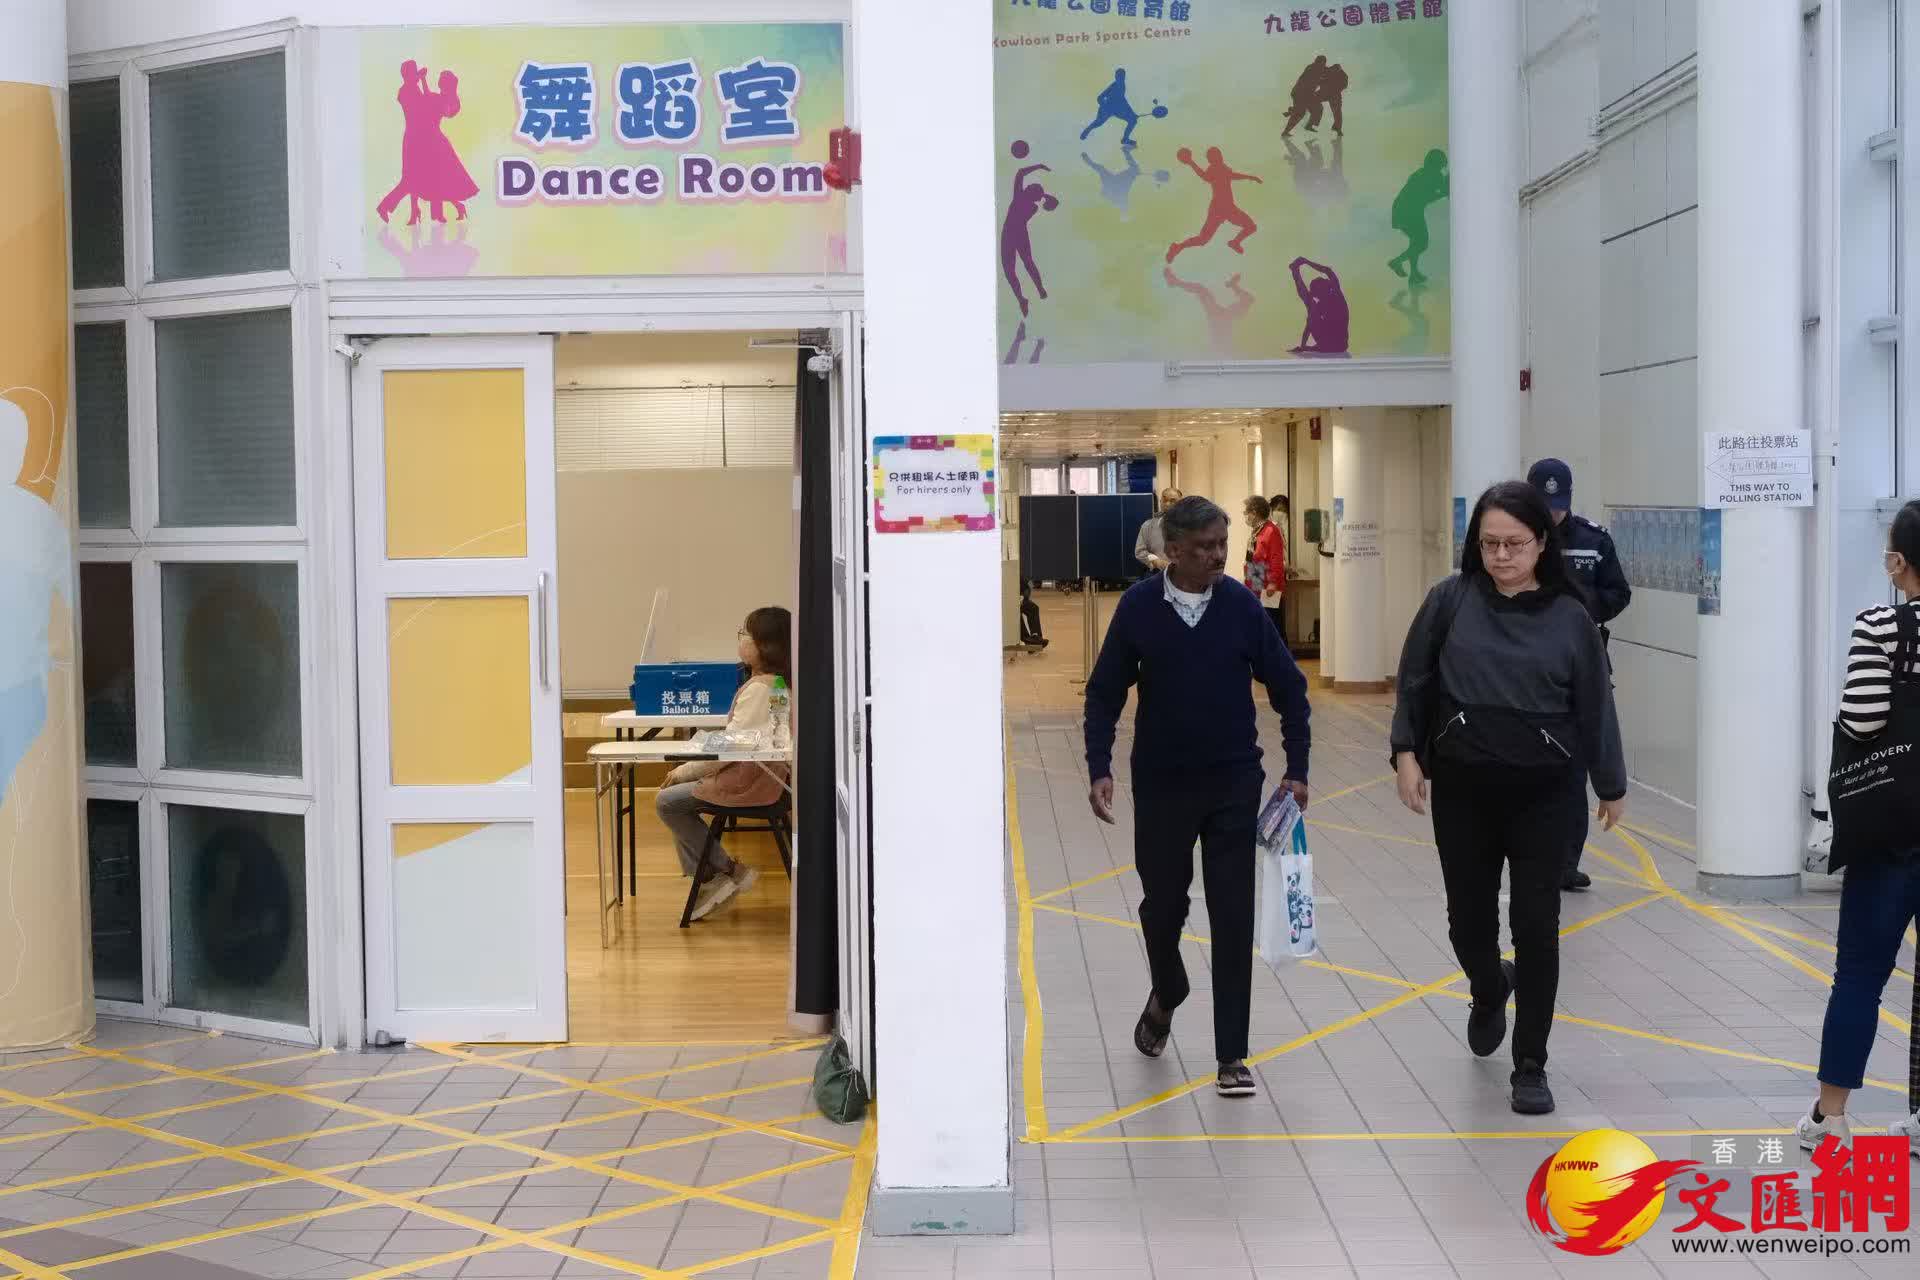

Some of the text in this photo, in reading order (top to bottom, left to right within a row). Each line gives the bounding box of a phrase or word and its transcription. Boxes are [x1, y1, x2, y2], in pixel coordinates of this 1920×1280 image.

[1056, 32, 1089, 44] Park
[1095, 31, 1138, 43] Sports
[1144, 27, 1191, 39] Centre
[517, 60, 797, 141] 舞蹈室
[503, 157, 825, 197] Dance Room
[1718, 435, 1799, 450] 此路往投票站
[897, 485, 971, 495] For hirers only
[1730, 483, 1790, 492] THIS WAY TO
[1719, 493, 1802, 503] POLLING STATION
[662, 691, 709, 704] 投票箱
[1830, 744, 1912, 780] ALLEN & OVERY
